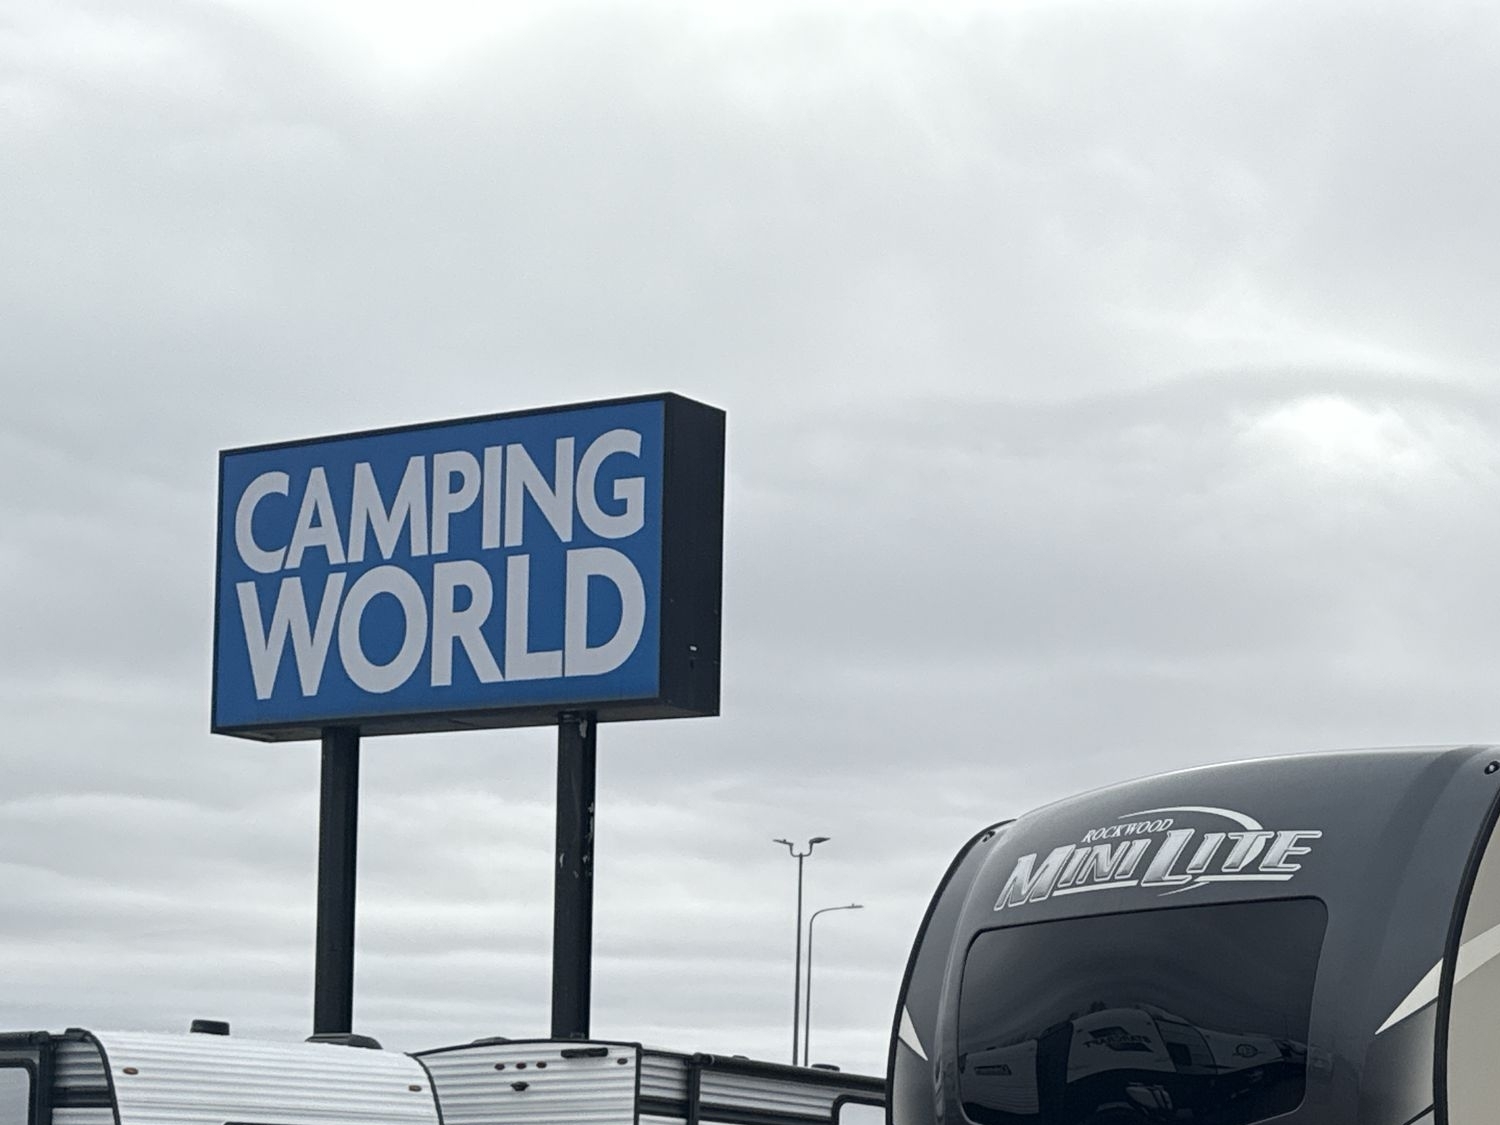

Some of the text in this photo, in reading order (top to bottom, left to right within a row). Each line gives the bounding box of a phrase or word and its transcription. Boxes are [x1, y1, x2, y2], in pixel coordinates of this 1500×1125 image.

[235, 428, 645, 573] CAMPING
[235, 546, 646, 701] WORLD
[1082, 818, 1174, 843] ROCKWOOD
